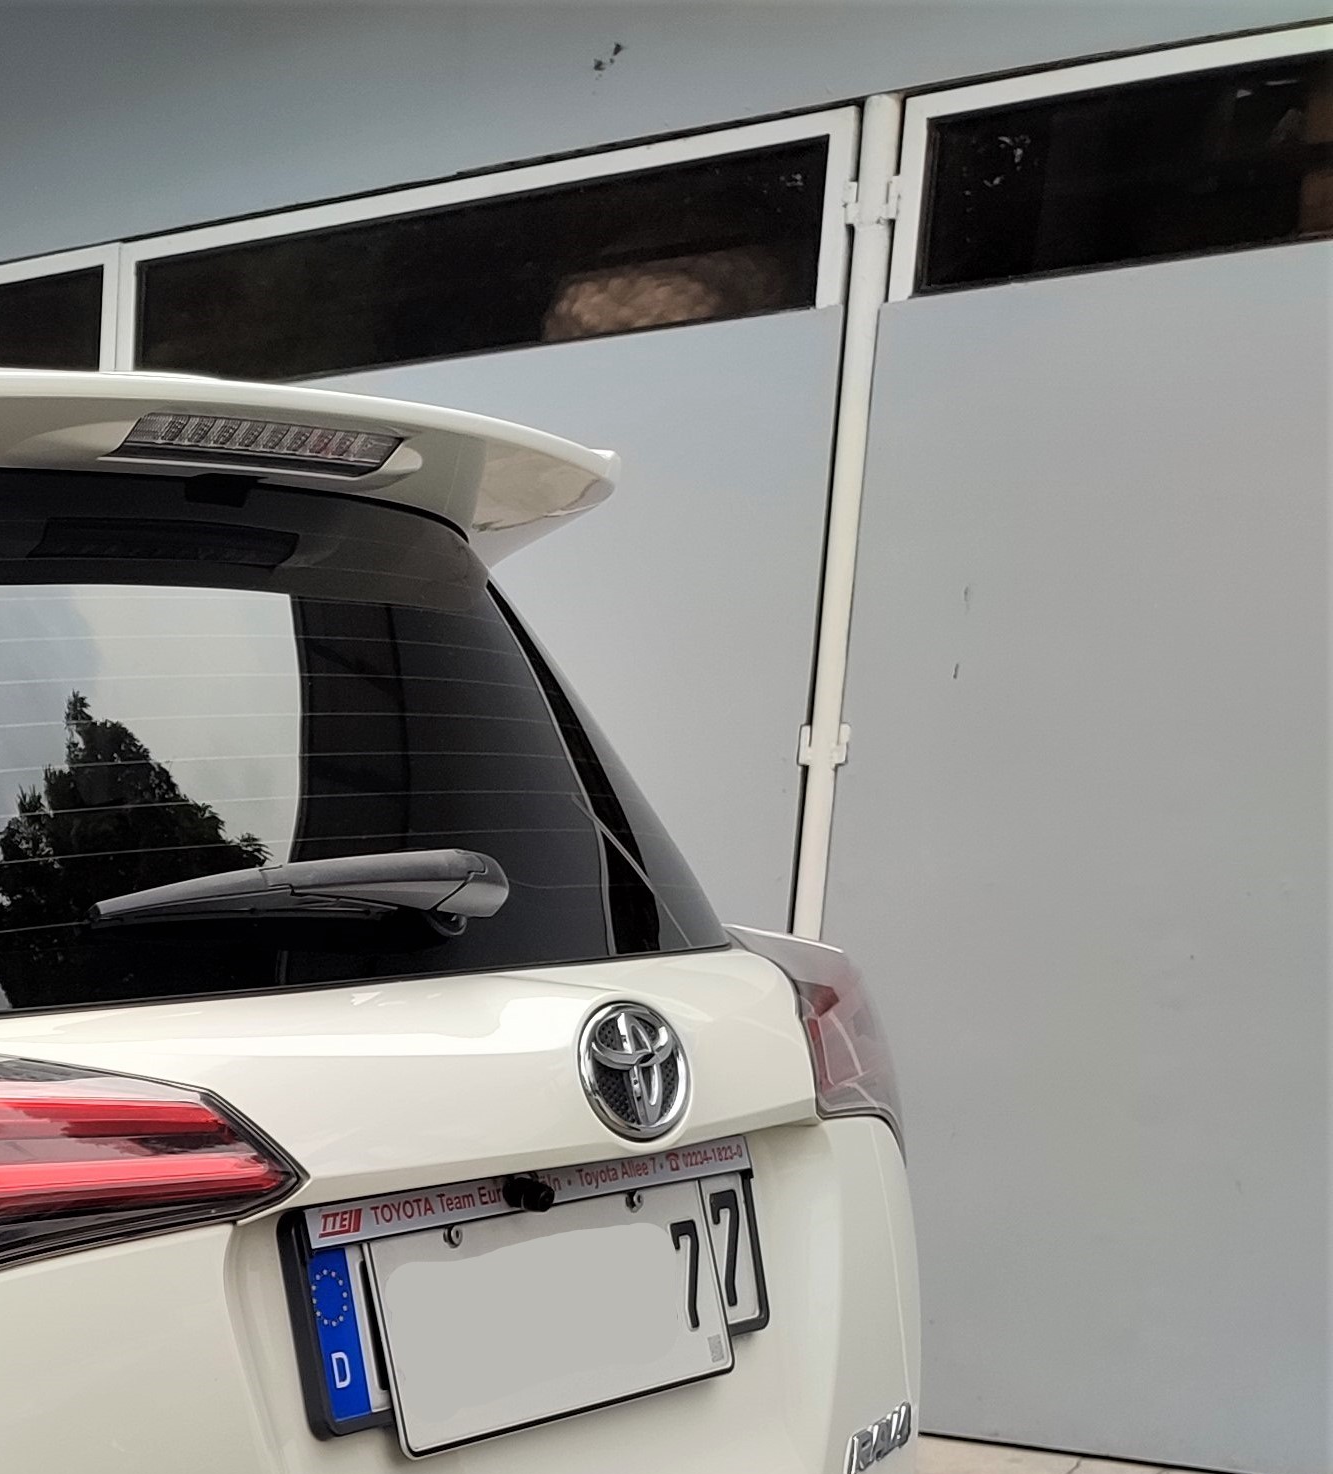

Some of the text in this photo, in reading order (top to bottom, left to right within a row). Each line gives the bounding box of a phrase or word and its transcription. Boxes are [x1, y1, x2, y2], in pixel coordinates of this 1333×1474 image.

[370, 1197, 435, 1226] TOYOTA
[436, 1190, 476, 1213] Team
[477, 1184, 506, 1206] Eur
[575, 1164, 619, 1190] Toyota
[621, 1158, 650, 1182] Allee
[649, 1157, 659, 1174] 7
[330, 1351, 351, 1389] D
